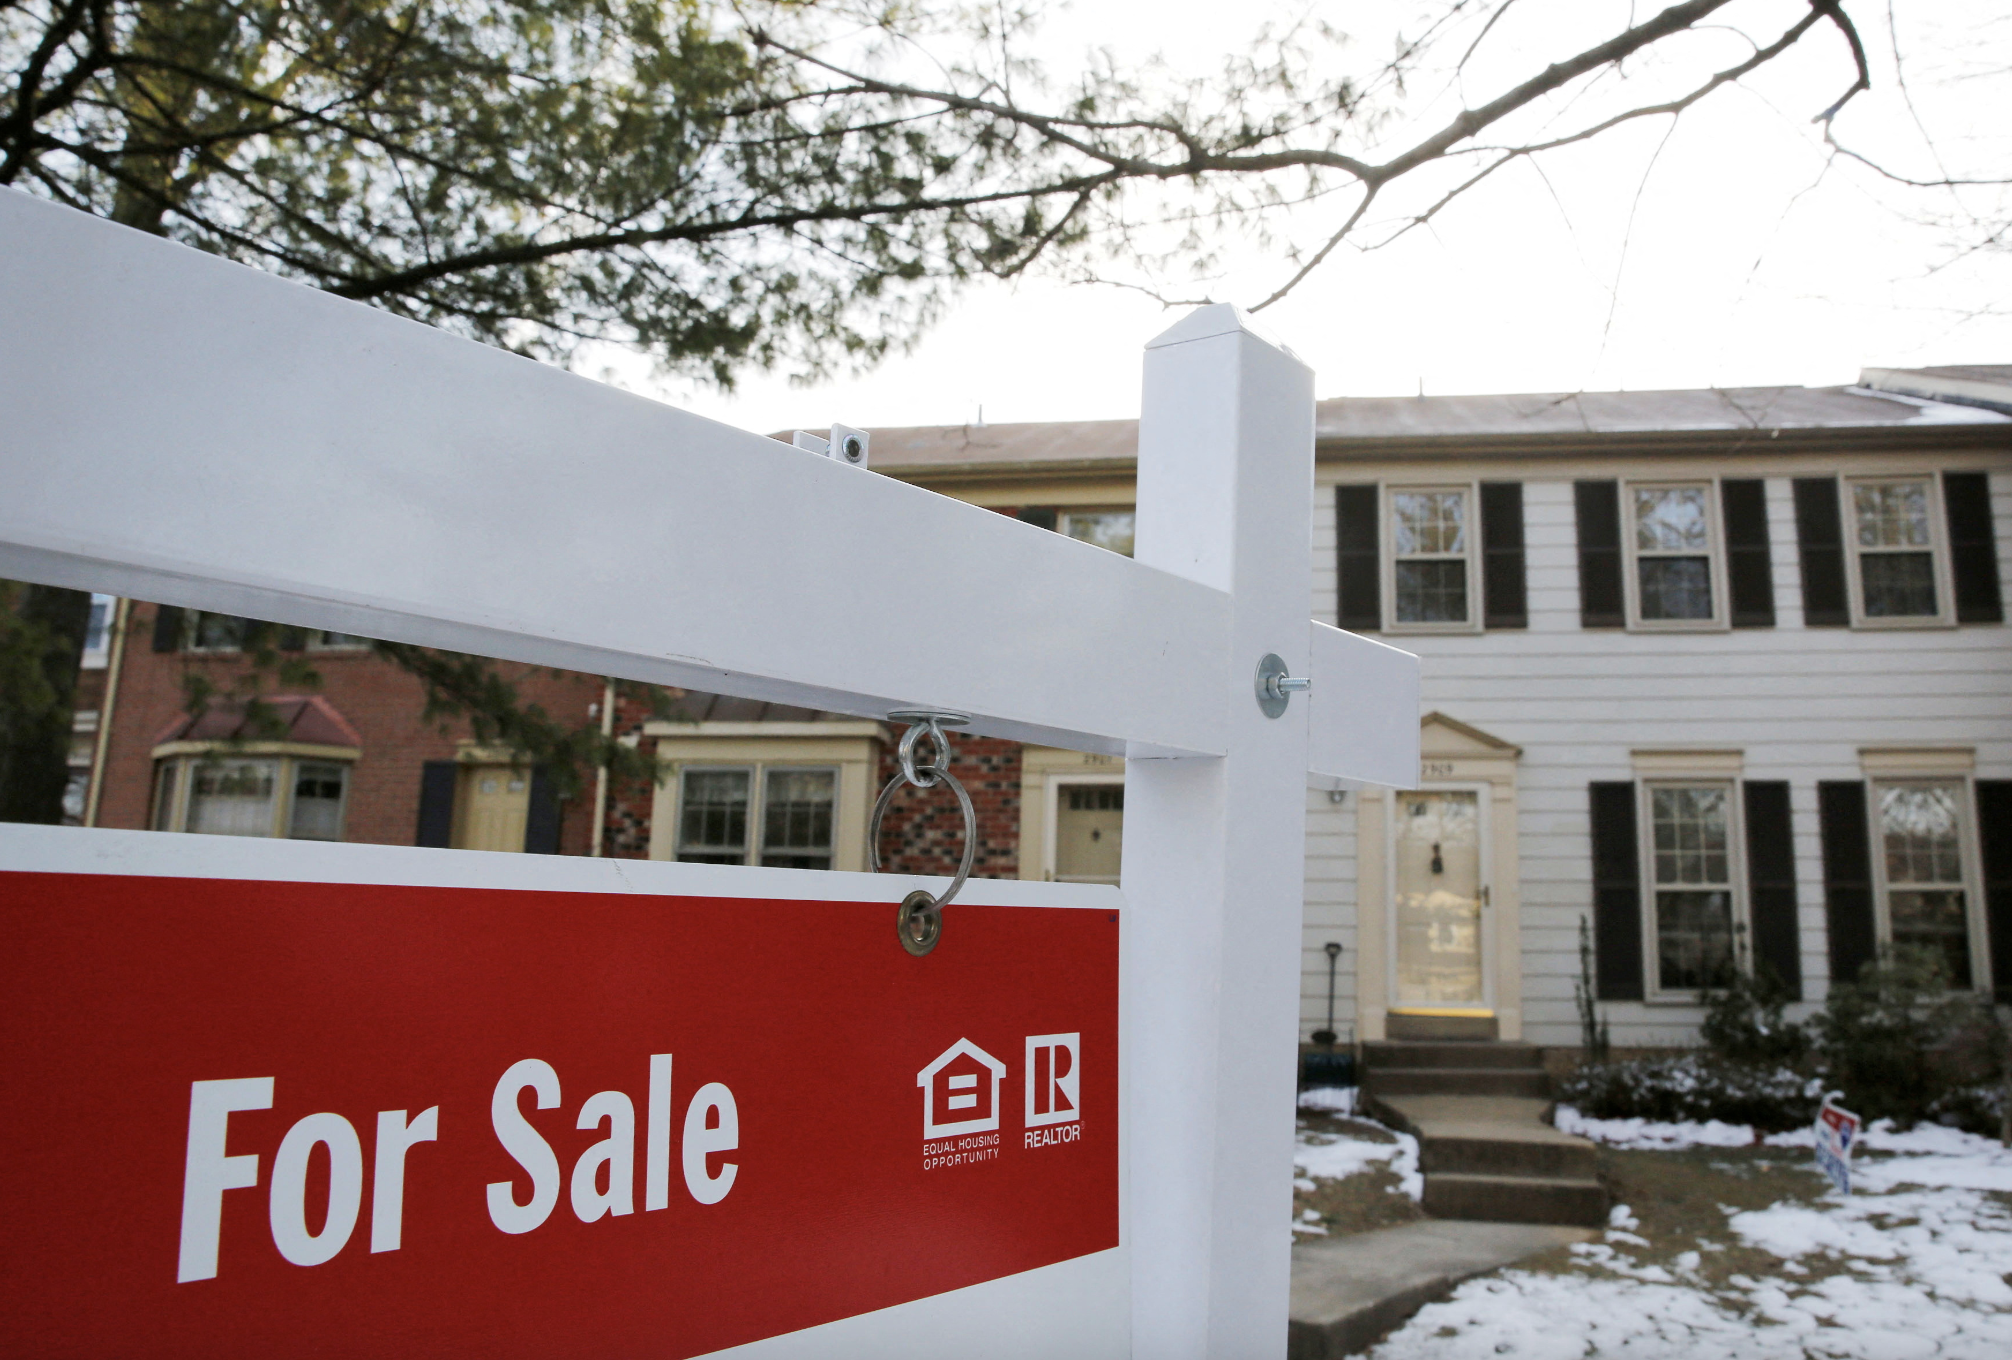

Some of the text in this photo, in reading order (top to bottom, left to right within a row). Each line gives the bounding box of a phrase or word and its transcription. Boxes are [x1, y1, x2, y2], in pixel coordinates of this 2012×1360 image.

[923, 1133, 1000, 1156] EQUAL HOUSING
[177, 1053, 740, 1283] For Sale
[923, 1148, 1000, 1171] OPPORTUNITY
